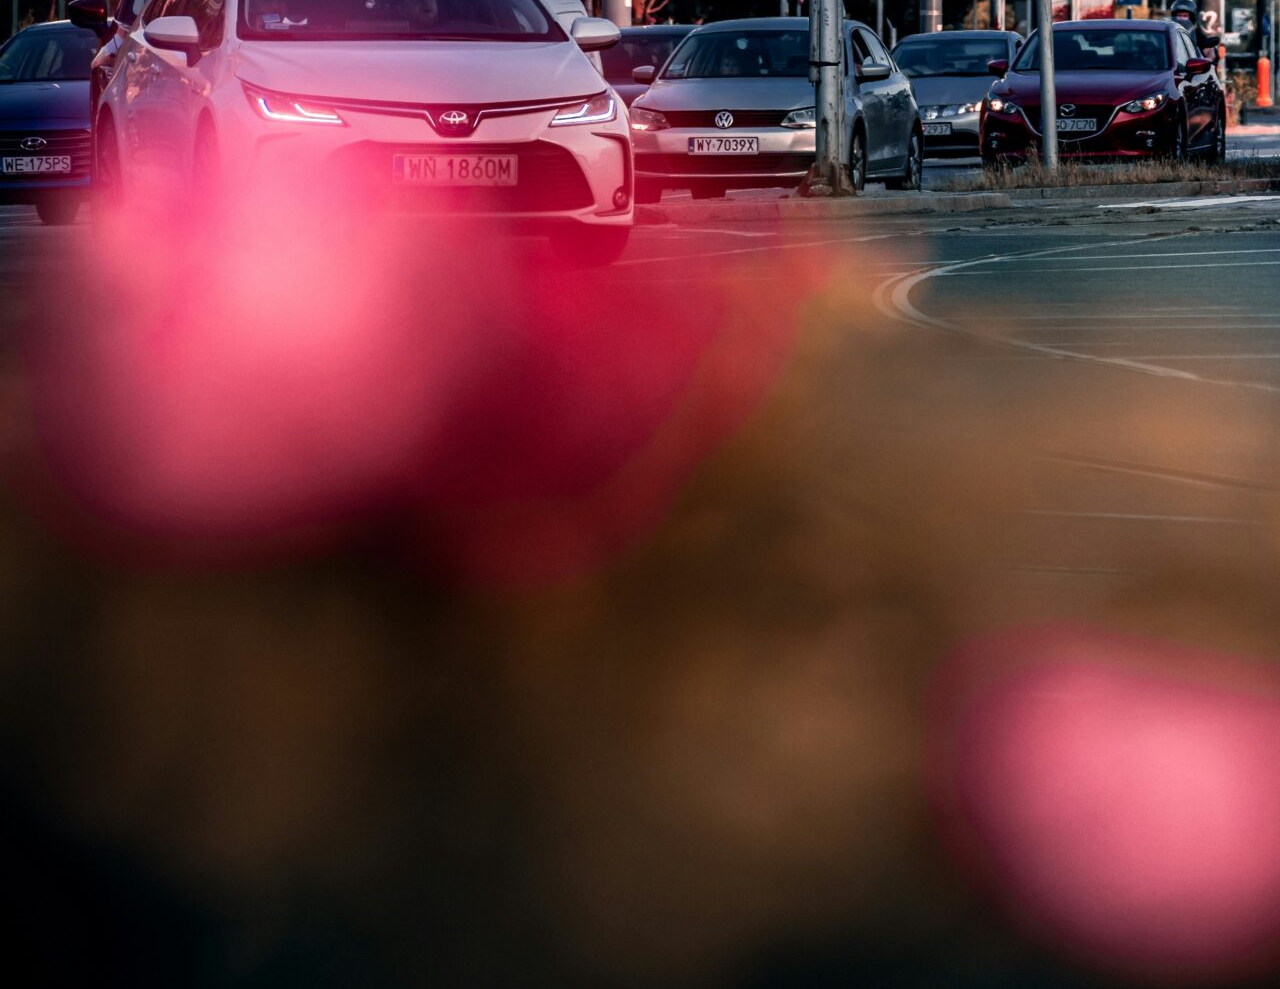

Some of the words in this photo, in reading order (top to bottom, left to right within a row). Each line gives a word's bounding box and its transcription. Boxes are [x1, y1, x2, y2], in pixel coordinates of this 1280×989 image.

[924, 124, 949, 134] 2937
[696, 139, 712, 152] WY
[716, 139, 755, 152] 7039X
[4, 158, 25, 172] WE
[29, 156, 70, 171] 175PS
[408, 158, 437, 180] WN
[447, 158, 511, 180] 1860M
